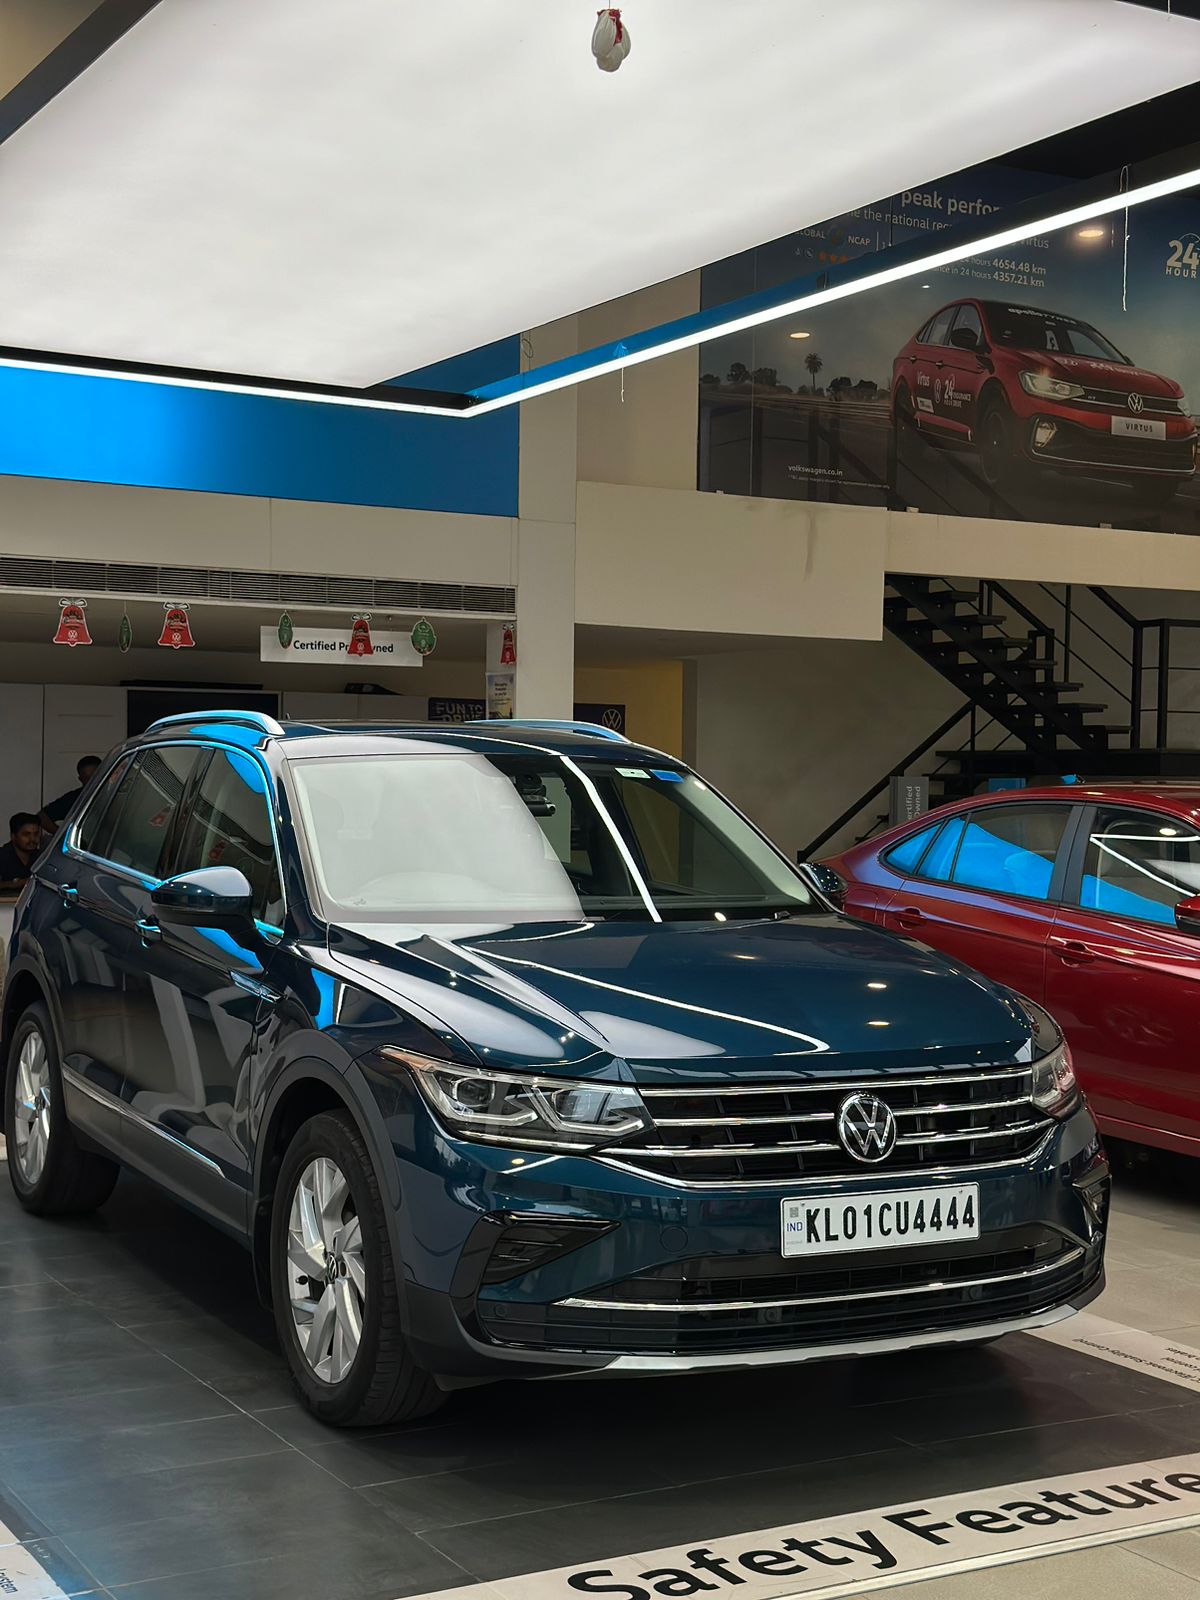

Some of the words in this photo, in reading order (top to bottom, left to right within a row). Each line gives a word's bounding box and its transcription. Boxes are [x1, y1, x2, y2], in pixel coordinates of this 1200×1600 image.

[901, 190, 943, 209] peak
[864, 208, 882, 222] the
[885, 214, 930, 230] national
[932, 221, 953, 231] rec
[796, 228, 826, 239] OBAL
[848, 235, 871, 246] NCAP
[1167, 239, 1199, 270] 24
[971, 256, 991, 267] hours
[992, 258, 1030, 273] 4654.48
[1031, 264, 1047, 275] km
[1165, 267, 1197, 279] HOUR
[951, 267, 959, 275] in
[960, 268, 970, 276] 24
[971, 269, 992, 280] hours
[993, 271, 1028, 286] 4357.21
[1030, 277, 1045, 288] km
[1125, 422, 1154, 433] VIRTUS
[788, 464, 844, 477] volkswagen.co.in
[293, 640, 337, 652] Certified
[436, 702, 466, 715] FUN
[905, 785, 913, 820] ertified
[786, 1221, 803, 1233] IND
[806, 1194, 975, 1243] KL01CU4444
[567, 1530, 898, 1600] Safety
[882, 1472, 1200, 1545] Feature
